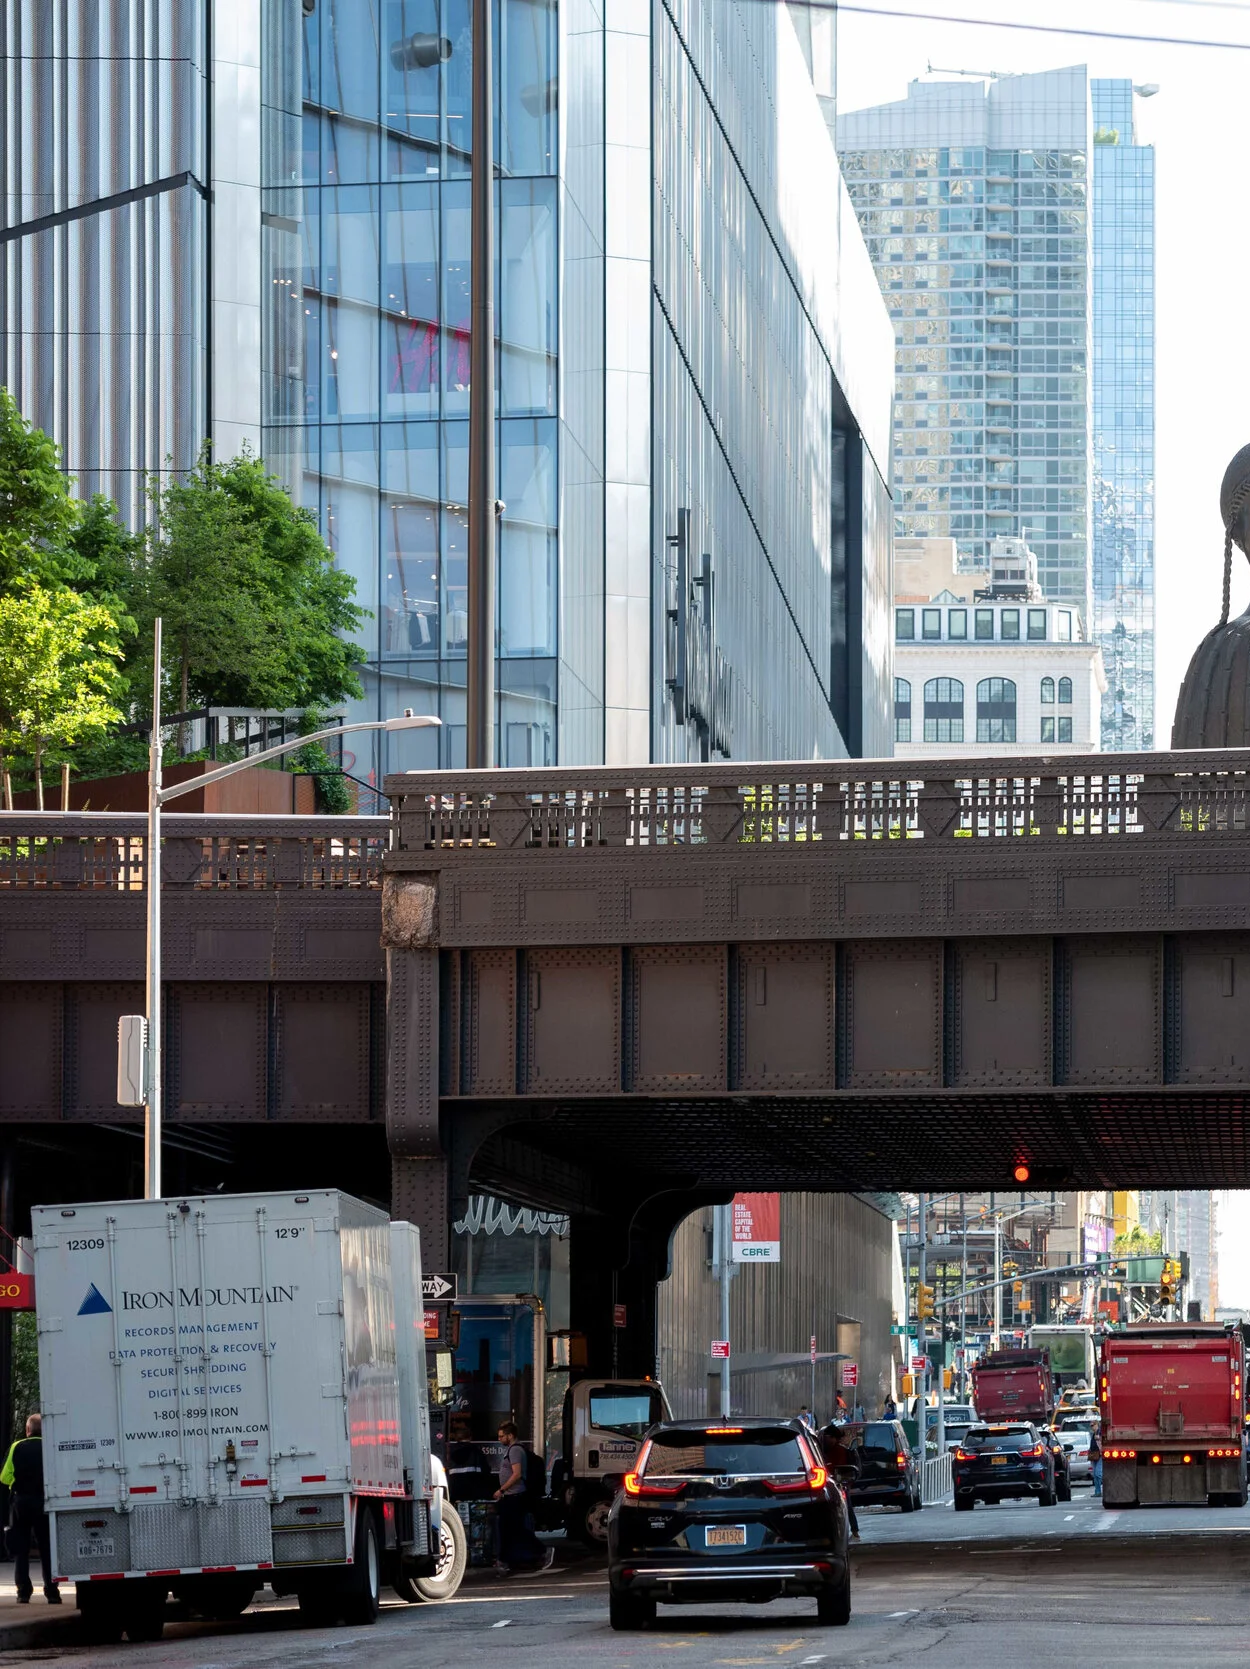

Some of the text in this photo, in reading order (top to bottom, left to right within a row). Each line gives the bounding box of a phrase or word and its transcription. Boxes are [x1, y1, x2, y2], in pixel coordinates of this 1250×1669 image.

[66, 1238, 105, 1251] 12309
[742, 1248, 770, 1256] CBRE
[422, 1281, 444, 1292] WAY
[122, 1285, 295, 1310] IRON MOUNTAIN
[125, 1321, 259, 1338] RECORDS MANAGEMENT
[109, 1341, 277, 1360] DATA PROTECTION & RECOVEY
[141, 1363, 247, 1379] SECUR SHRDDING
[600, 1440, 636, 1452] Tanner
